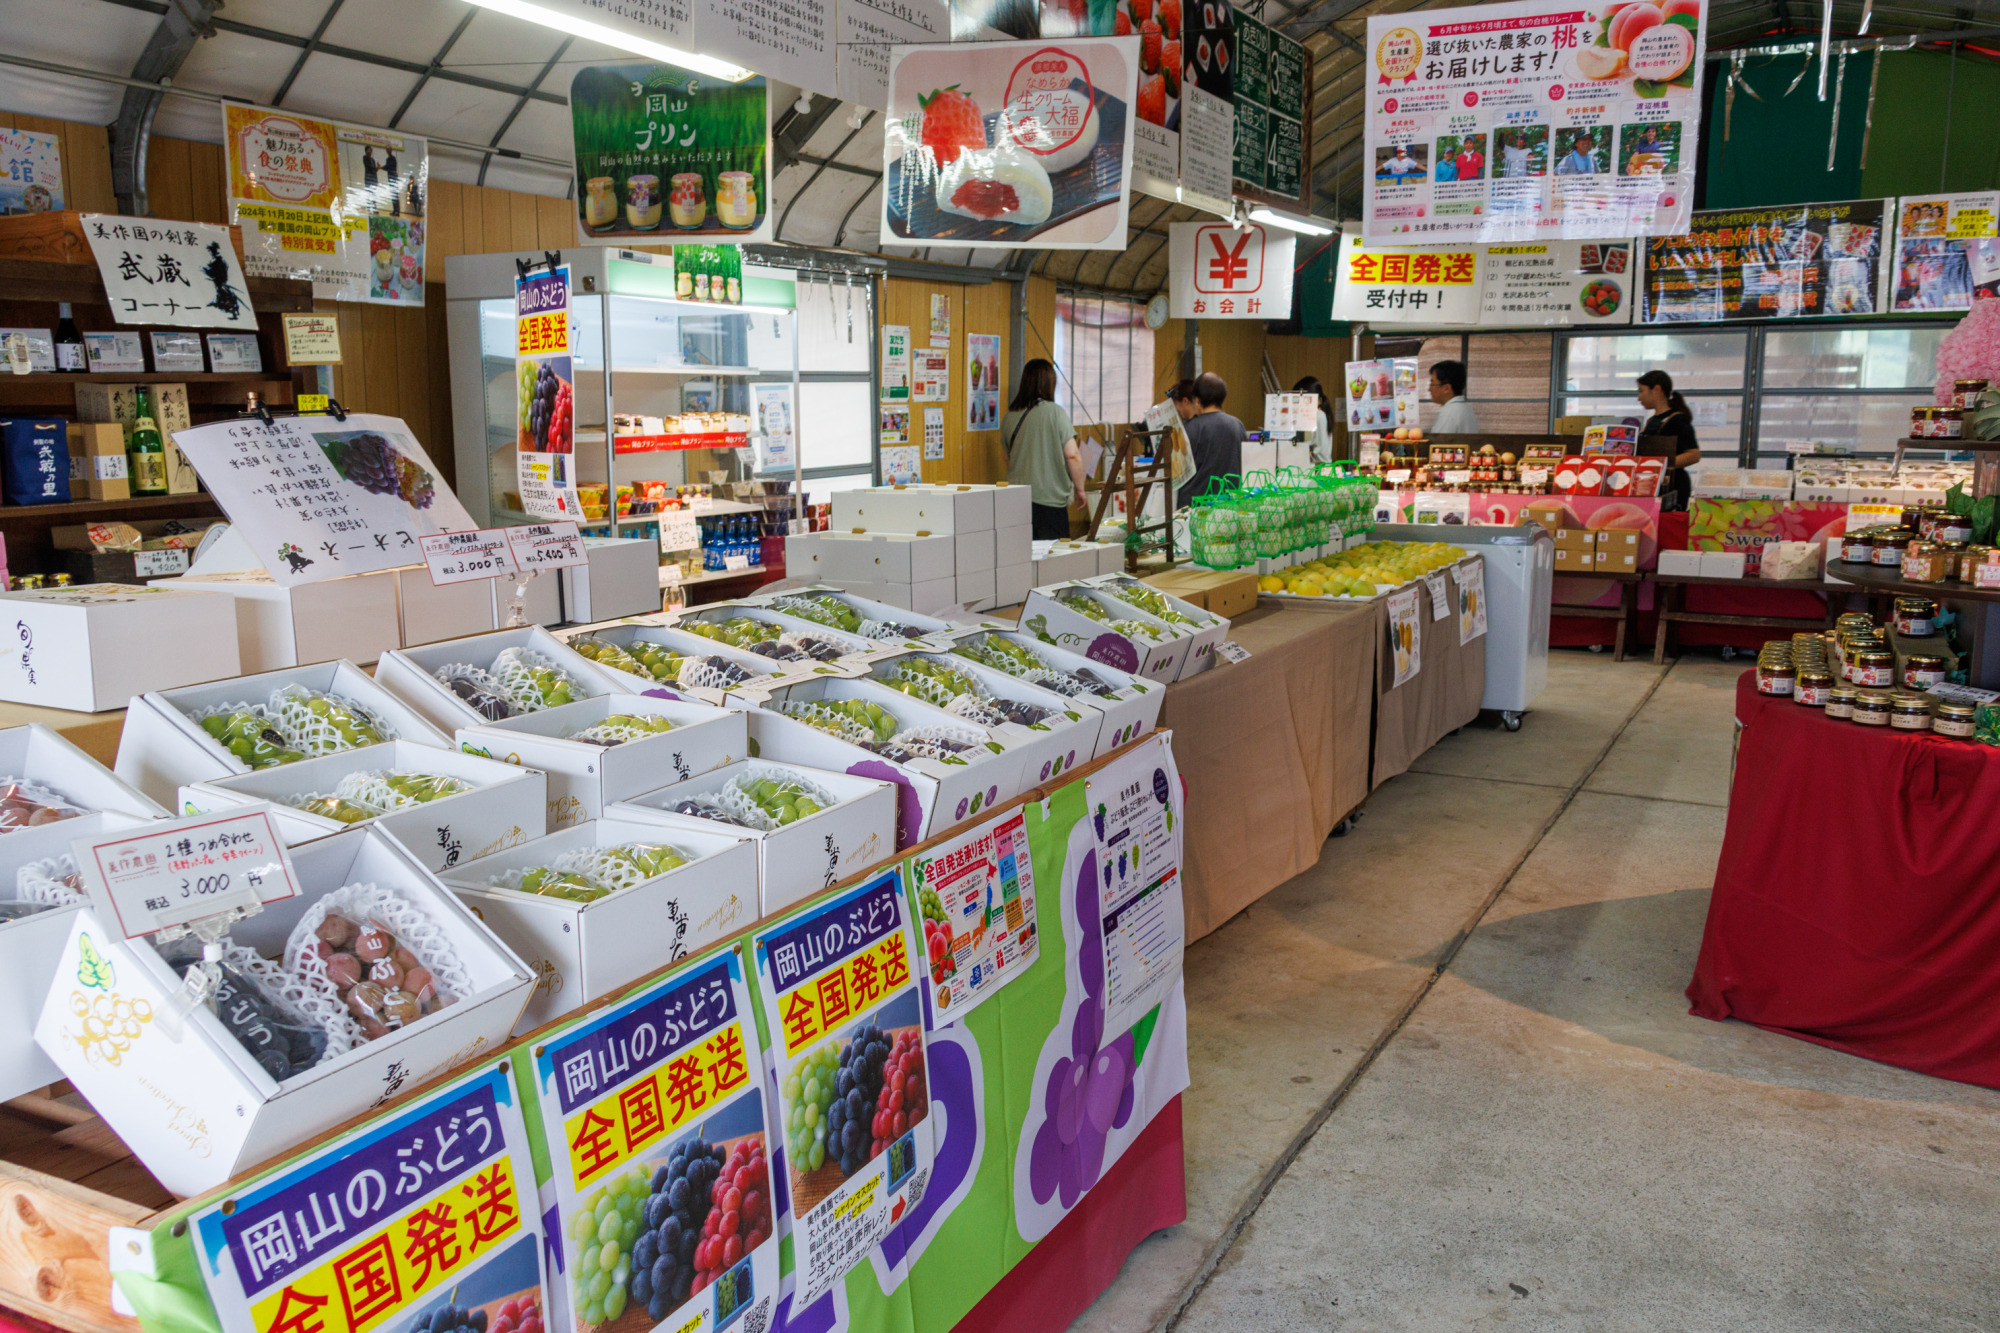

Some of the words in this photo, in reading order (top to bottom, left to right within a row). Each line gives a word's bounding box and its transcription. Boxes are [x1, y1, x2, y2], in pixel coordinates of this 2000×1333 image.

[1388, 39, 1411, 47] 岡山の桃
[1426, 25, 1592, 56] 選び抜いた農家の桃を
[1385, 56, 1414, 65] 全国トップ
[1388, 65, 1409, 73] クラス!
[1426, 51, 1558, 80] お届けします!
[1635, 59, 1681, 68] 自慢の白桃です!
[1027, 77, 1071, 88] なめらか
[646, 94, 688, 118] 岡山
[1016, 90, 1072, 112] 生クリーム
[1044, 106, 1079, 126] 大福
[266, 138, 304, 154] 魅力ある
[635, 121, 696, 150] プリン
[258, 151, 314, 175] 食の祭典
[600, 152, 732, 168] 岡山の自然の恵みをいただきます
[1268, 133, 1277, 177] 4
[93, 223, 199, 247] 美作国の剣豪
[281, 235, 336, 253] 特別賞受賞
[118, 251, 191, 287] 武蔵
[1209, 233, 1248, 289] ¥
[1350, 254, 1475, 284] 全国発送
[1503, 271, 1562, 281] プロが認めたいちご
[121, 298, 201, 316] コーナー
[519, 281, 567, 314] 岡山のぶどう
[1194, 299, 1262, 315] お会計
[1366, 290, 1444, 310] 受付中!
[519, 317, 568, 352] 全国発送
[229, 451, 313, 470] すっきり酸味
[270, 464, 324, 478] 強い甘み
[320, 531, 414, 561] ピオーネ
[672, 531, 690, 545] 580
[1725, 532, 1782, 546] Sweet
[443, 567, 456, 575] 税込
[458, 557, 492, 573] 3.000
[495, 556, 505, 567] 円
[537, 548, 564, 561] 5.400
[569, 547, 578, 558] 円
[158, 564, 176, 572] 420
[108, 853, 158, 874] 美作農園
[925, 833, 993, 883] 全国発送承ります!
[145, 896, 170, 911] 税込
[181, 873, 230, 898] 3.000
[248, 871, 262, 887] 円
[774, 892, 896, 986] 岡山のぶどう
[783, 933, 910, 1050] 全国発送
[563, 979, 728, 1105] 岡山のぶどう
[572, 1027, 748, 1182] 全国発送
[241, 1105, 493, 1283] 岡山のぶどう
[807, 1189, 849, 1227] 美作農園では、
[808, 1171, 886, 1242] 大人気のシャインマスカットや
[808, 1194, 875, 1255] 岡山を代表するピオーネ
[266, 1162, 520, 1333] 全国発送
[807, 1205, 888, 1287] ご注文は直売所レジ
[809, 1213, 869, 1268] を取り扱っております。
